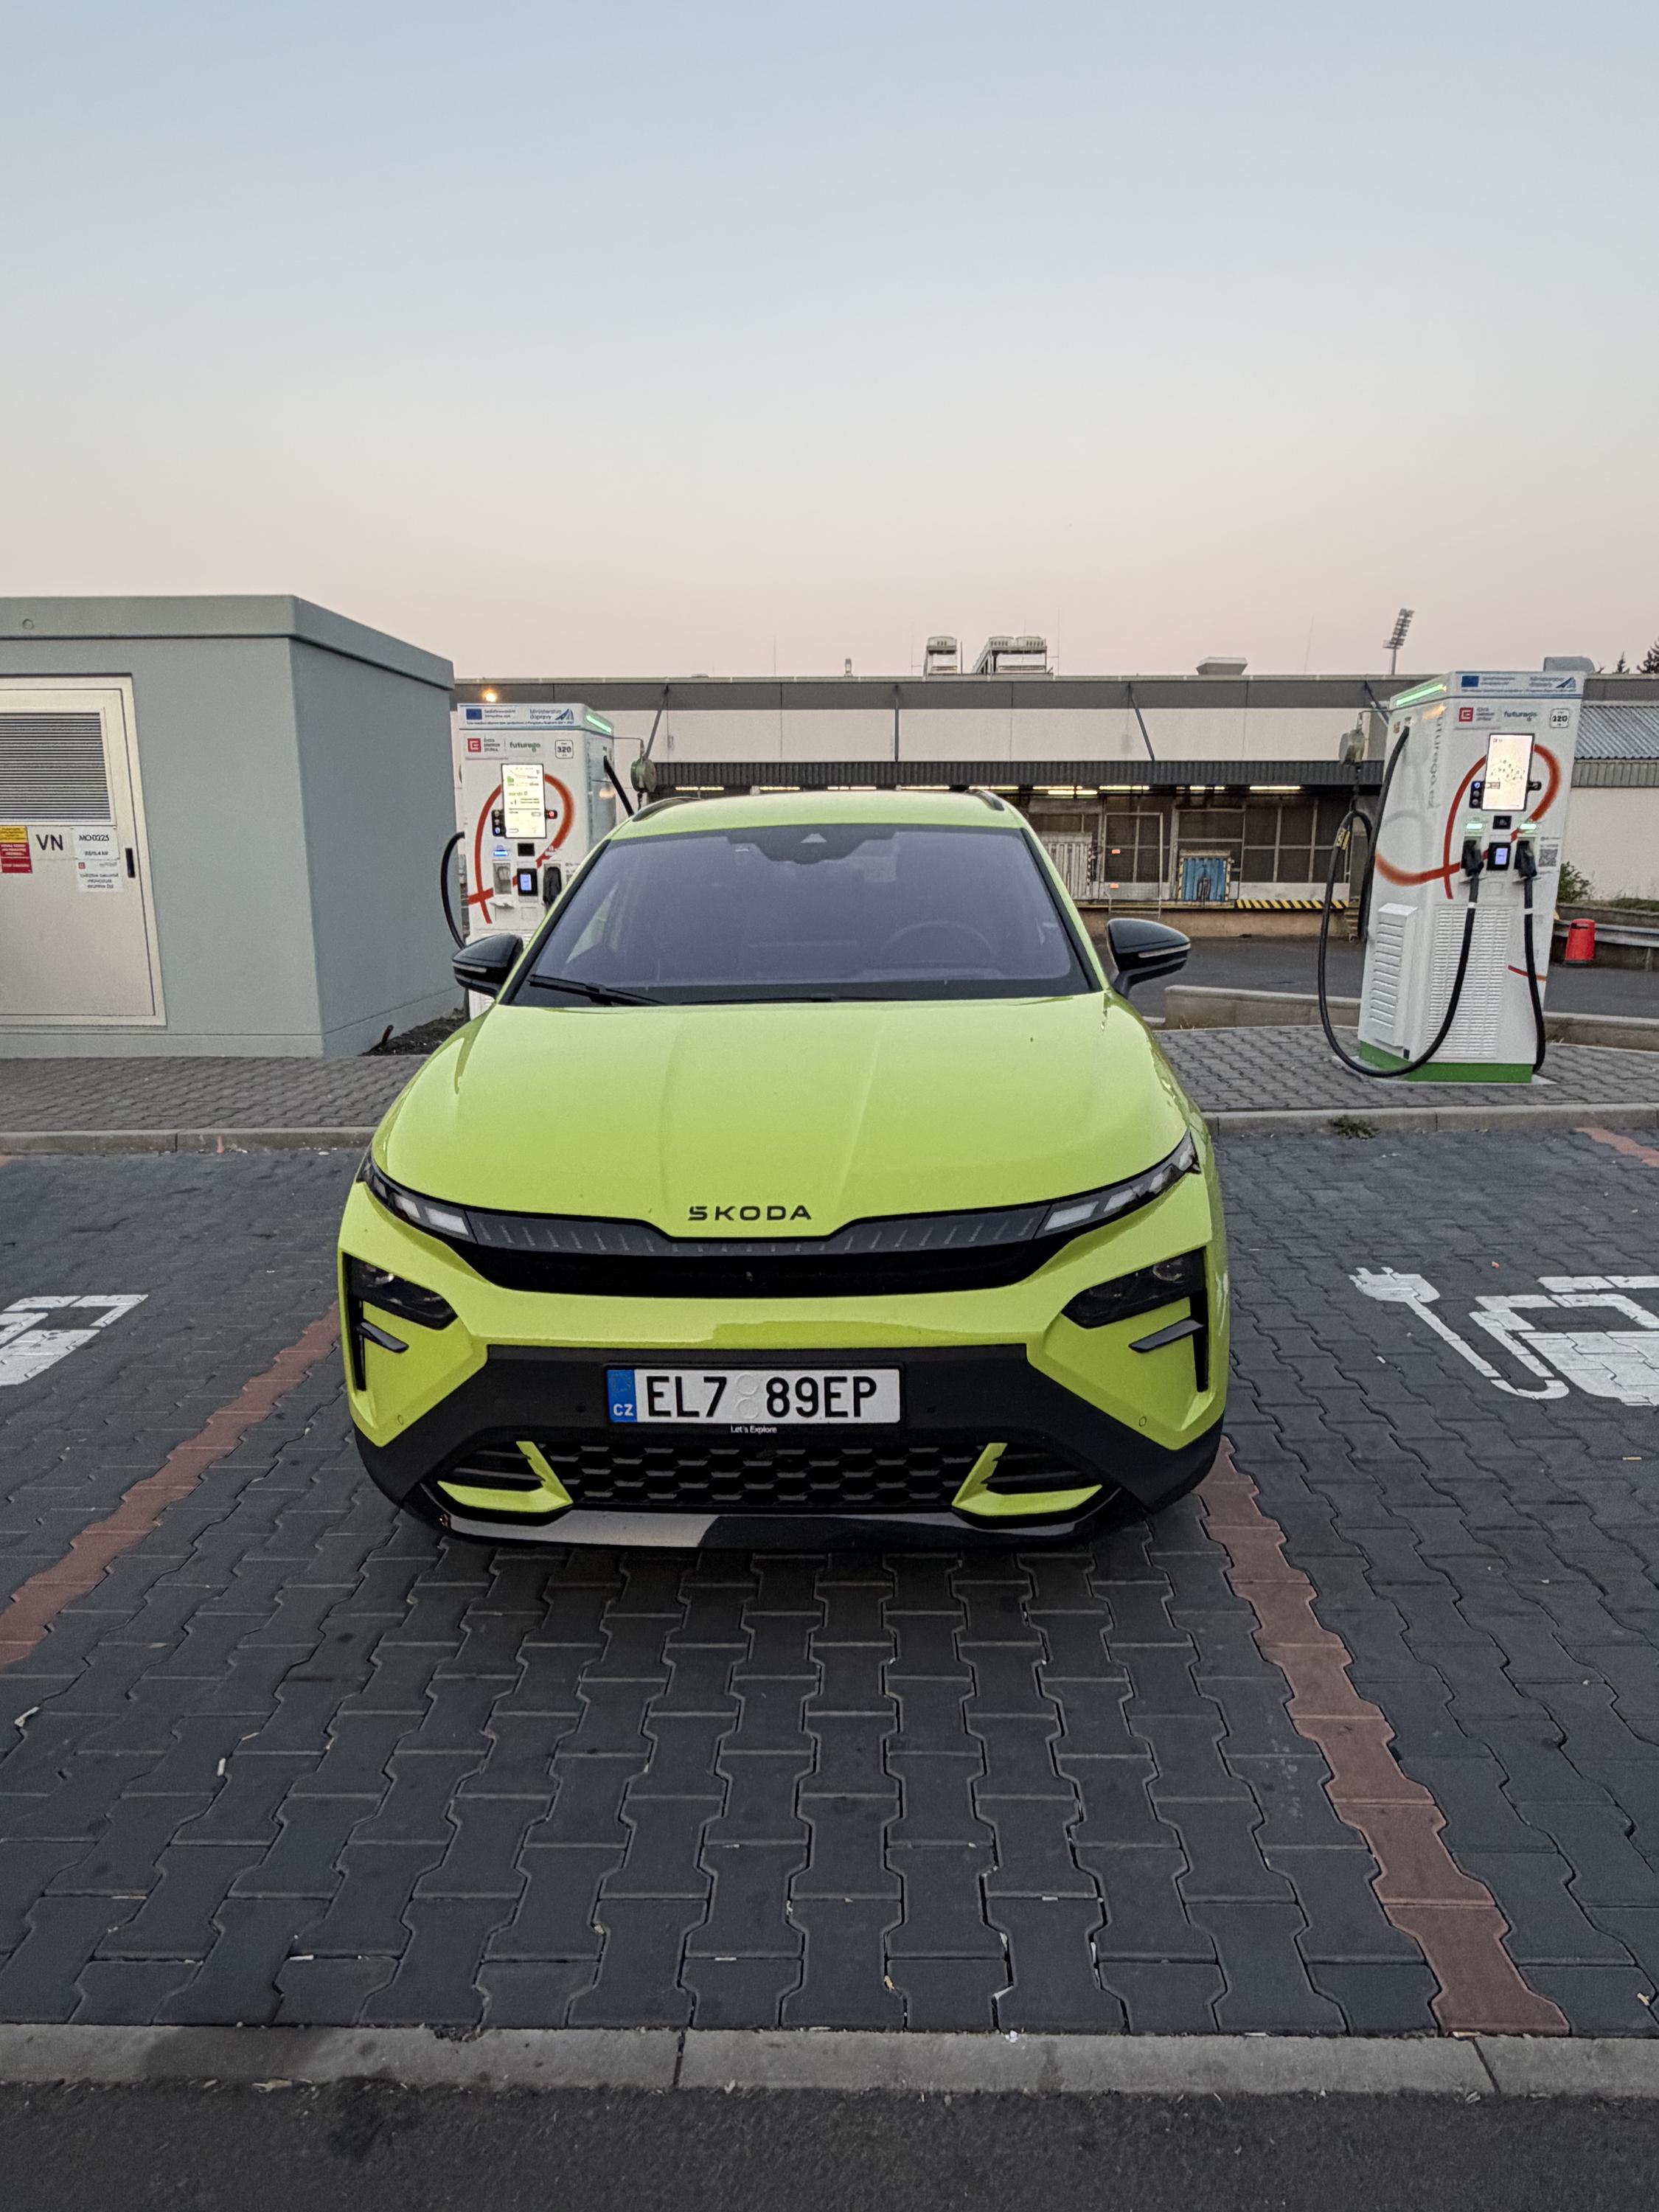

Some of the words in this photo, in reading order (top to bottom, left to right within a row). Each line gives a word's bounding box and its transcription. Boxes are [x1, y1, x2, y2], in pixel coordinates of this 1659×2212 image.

[35, 834, 64, 851] VN
[646, 1376, 727, 1417] EL7
[765, 1376, 877, 1418] 89EP
[613, 1404, 634, 1416] CZ
[730, 1425, 749, 1433] Let's
[749, 1425, 778, 1435] Explore
